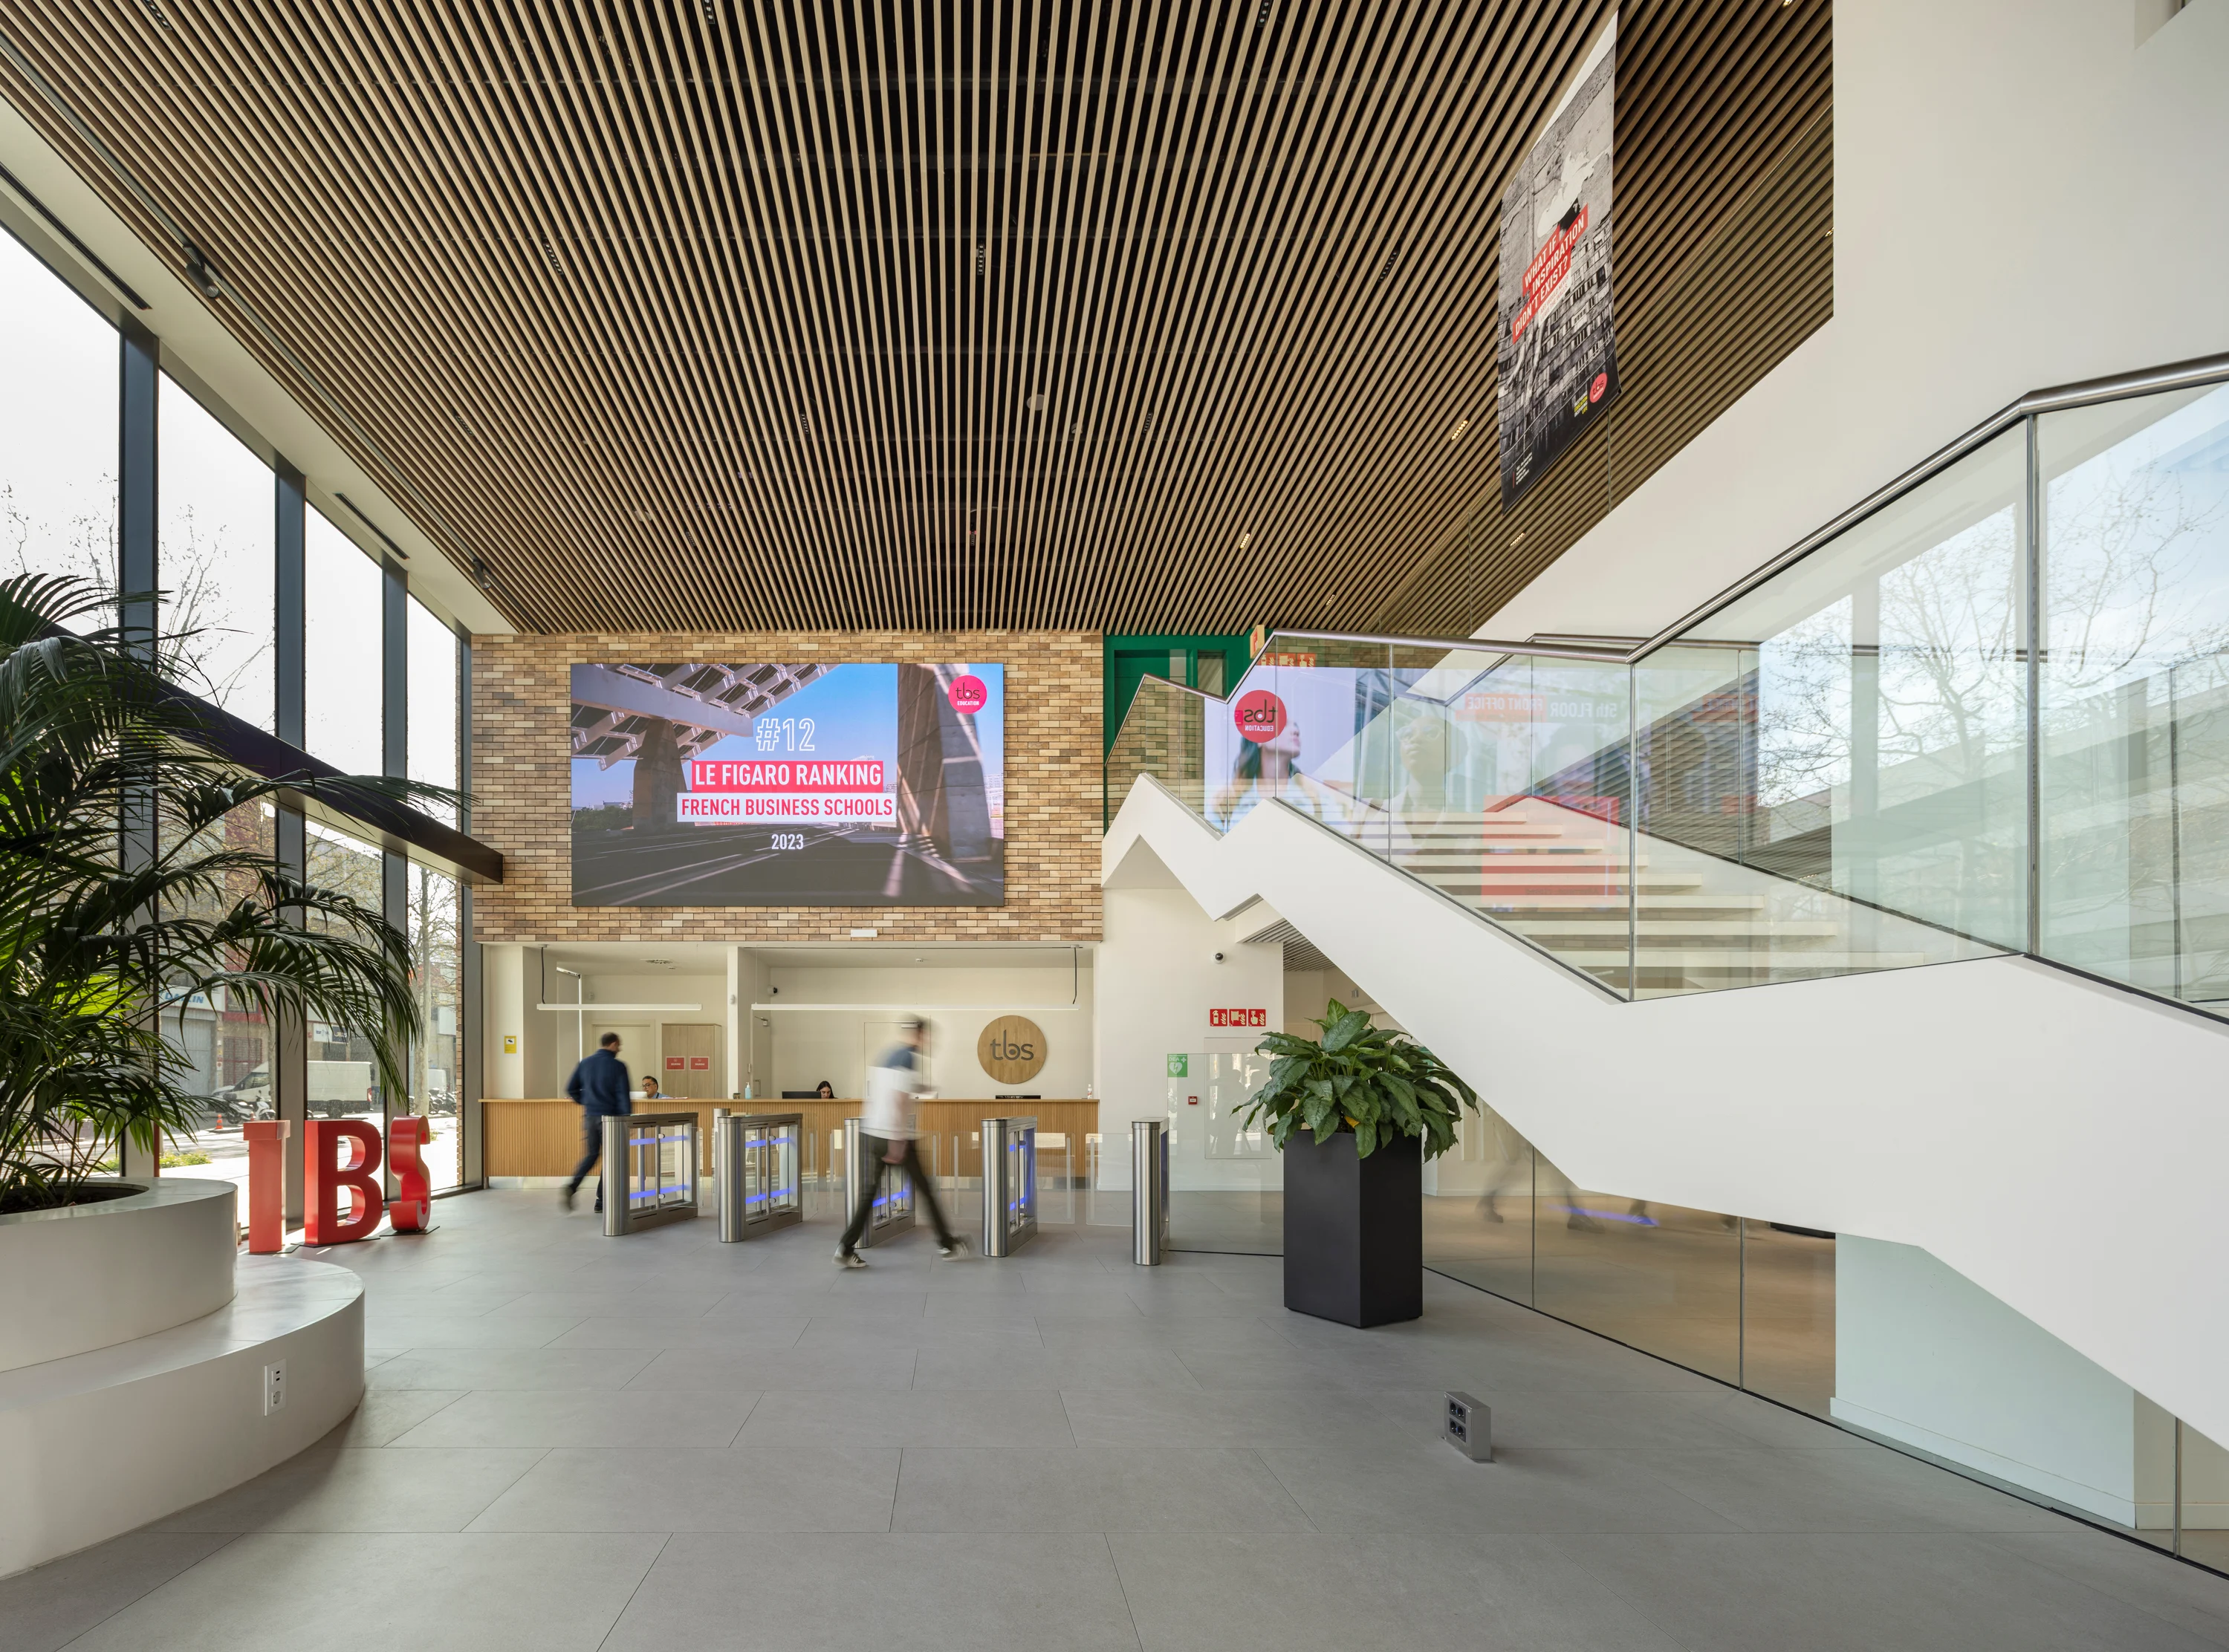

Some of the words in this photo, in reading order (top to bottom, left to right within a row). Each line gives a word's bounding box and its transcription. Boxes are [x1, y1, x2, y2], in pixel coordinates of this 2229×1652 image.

[1525, 247, 1548, 288] WHAT
[1549, 235, 1557, 254] IF
[1532, 214, 1585, 296] INSPIRATION
[1516, 293, 1539, 336] DIDN'T
[1540, 255, 1568, 301] EXIST?
[1592, 380, 1604, 396] tbs
[955, 681, 981, 700] tbs
[756, 718, 815, 752] #12
[695, 764, 716, 785] LE
[721, 764, 790, 785] FIGARO
[796, 764, 881, 785] RANKING
[681, 799, 740, 816] FRENCH
[745, 799, 820, 816] BUSINESS
[824, 799, 893, 816] SCHOOLS
[771, 833, 804, 851] 2023
[990, 1029, 1034, 1061] tbs
[243, 1115, 432, 1254] TBS
